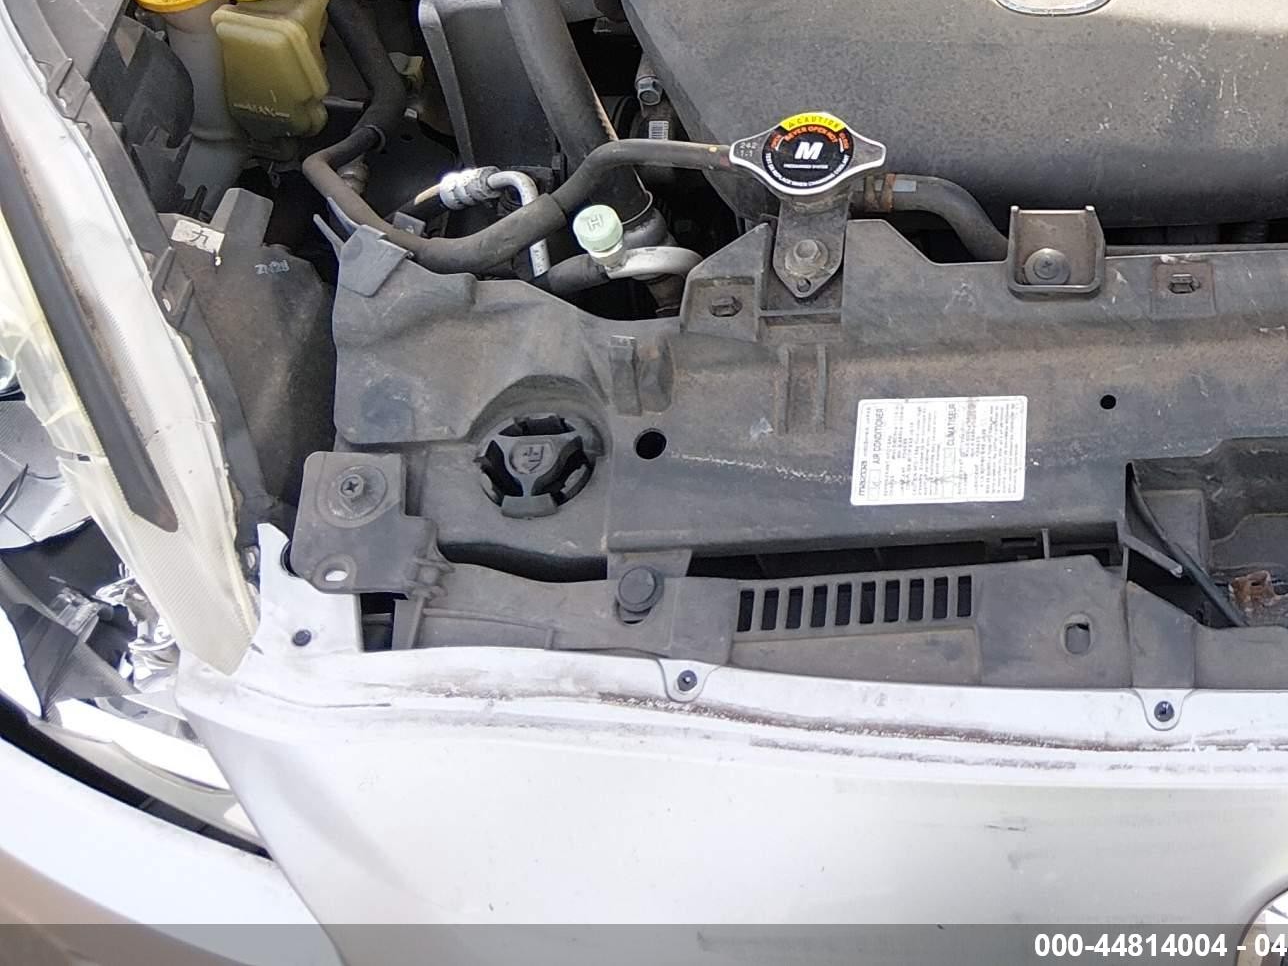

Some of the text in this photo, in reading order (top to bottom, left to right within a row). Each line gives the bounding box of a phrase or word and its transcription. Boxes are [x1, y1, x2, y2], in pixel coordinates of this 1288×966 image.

[796, 115, 842, 129] CAUTION
[794, 141, 824, 160] M
[872, 408, 884, 465] AIR CONDITIONER
[945, 403, 957, 447] CLIMATISEUR
